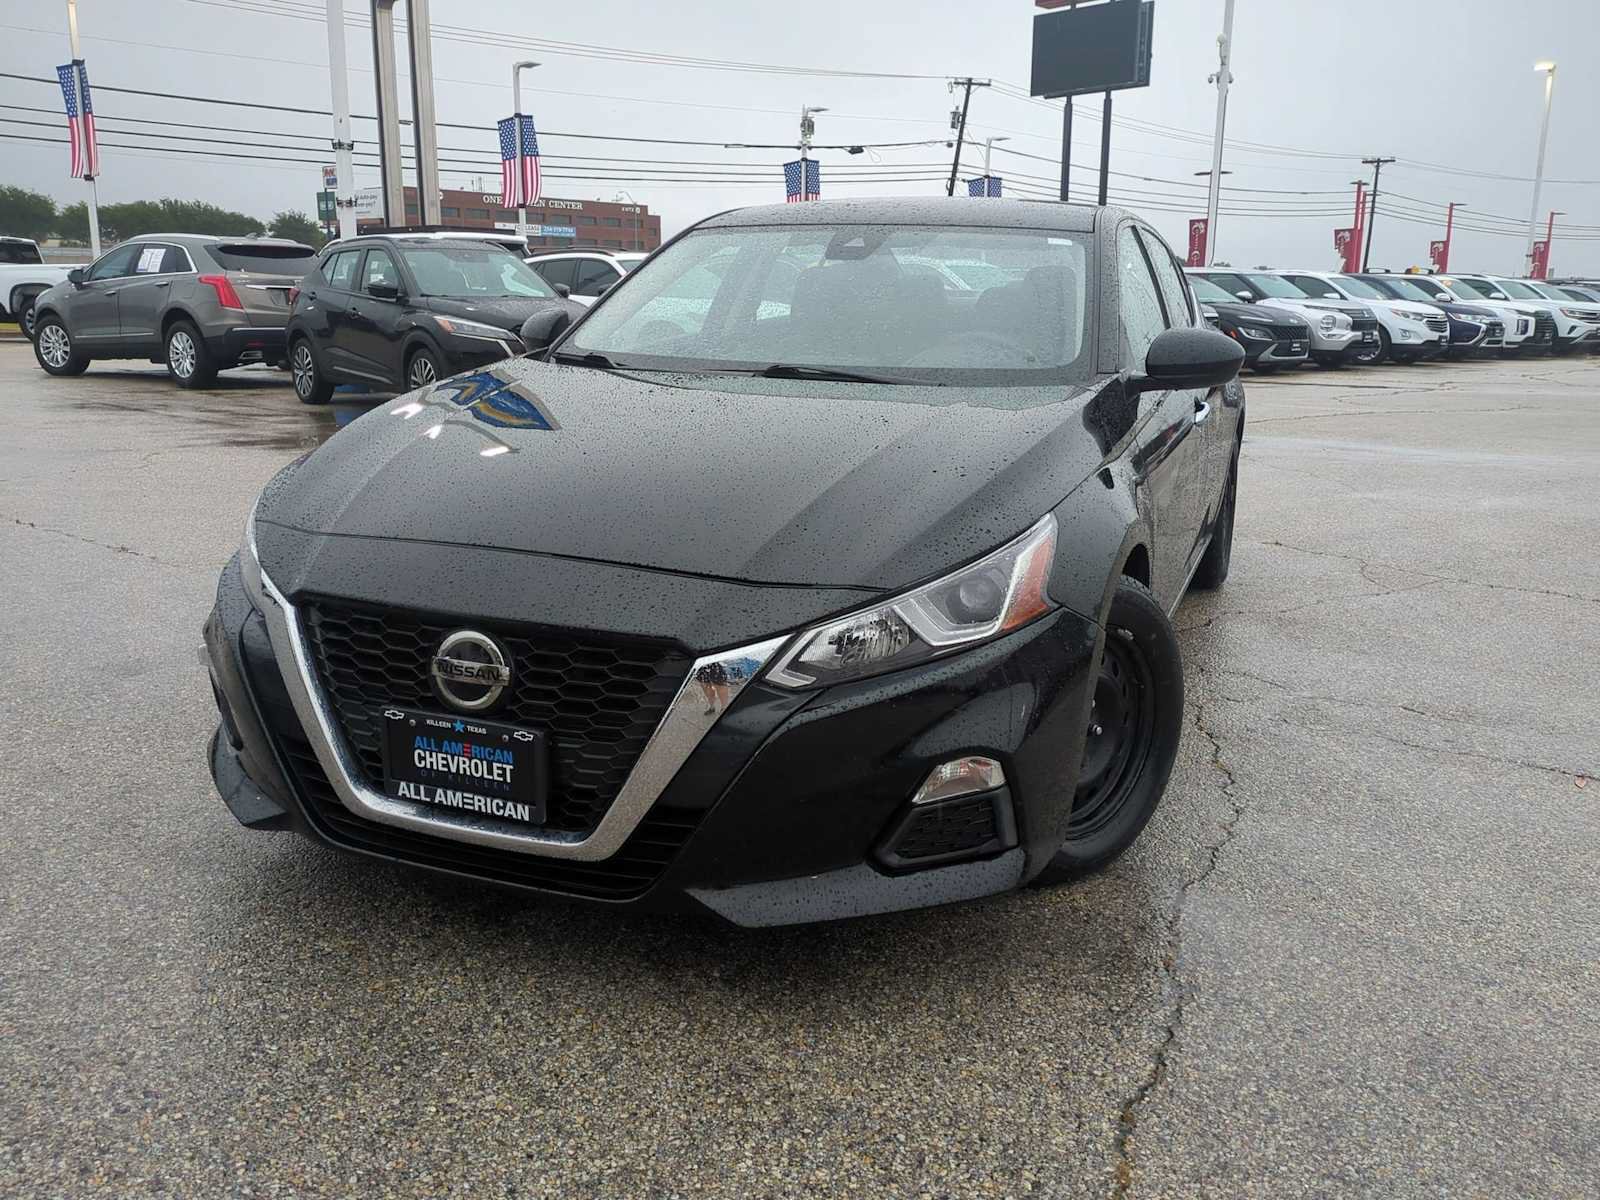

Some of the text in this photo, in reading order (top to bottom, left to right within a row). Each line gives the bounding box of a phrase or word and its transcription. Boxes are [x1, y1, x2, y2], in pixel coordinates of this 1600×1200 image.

[482, 195, 503, 205] ONE
[548, 200, 583, 210] CENTER
[438, 662, 501, 681] NISSAN
[426, 719, 487, 735] KILLEEN TEXAS
[414, 736, 514, 764] ALL AMERICAN
[413, 749, 514, 783] CHEVROLET
[397, 781, 530, 822] ALL AMERICAN
